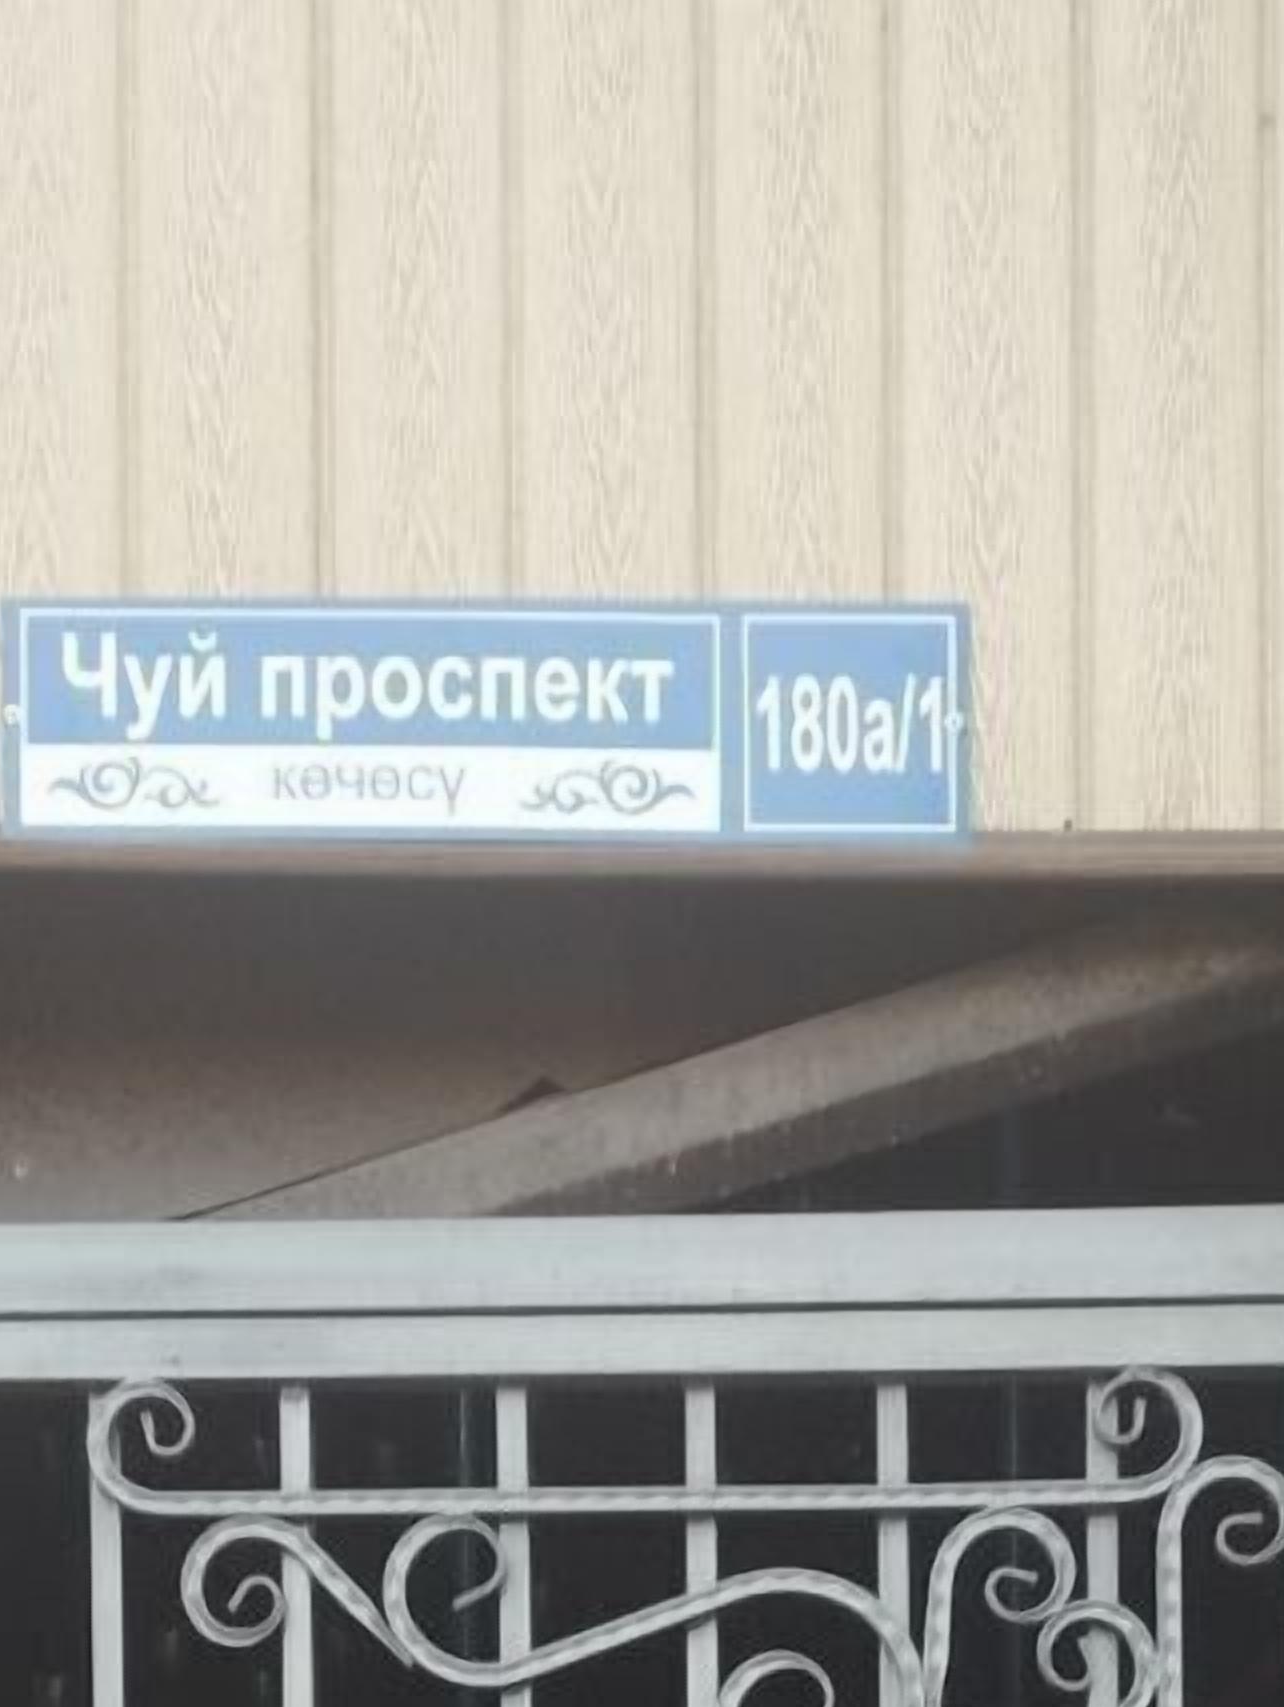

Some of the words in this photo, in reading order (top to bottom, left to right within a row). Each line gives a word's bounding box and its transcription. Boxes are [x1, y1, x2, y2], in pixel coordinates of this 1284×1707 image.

[61, 621, 226, 740] Чуй
[261, 654, 675, 741] проспект
[755, 671, 944, 776] 180а/1
[272, 762, 466, 818] көчөсү
